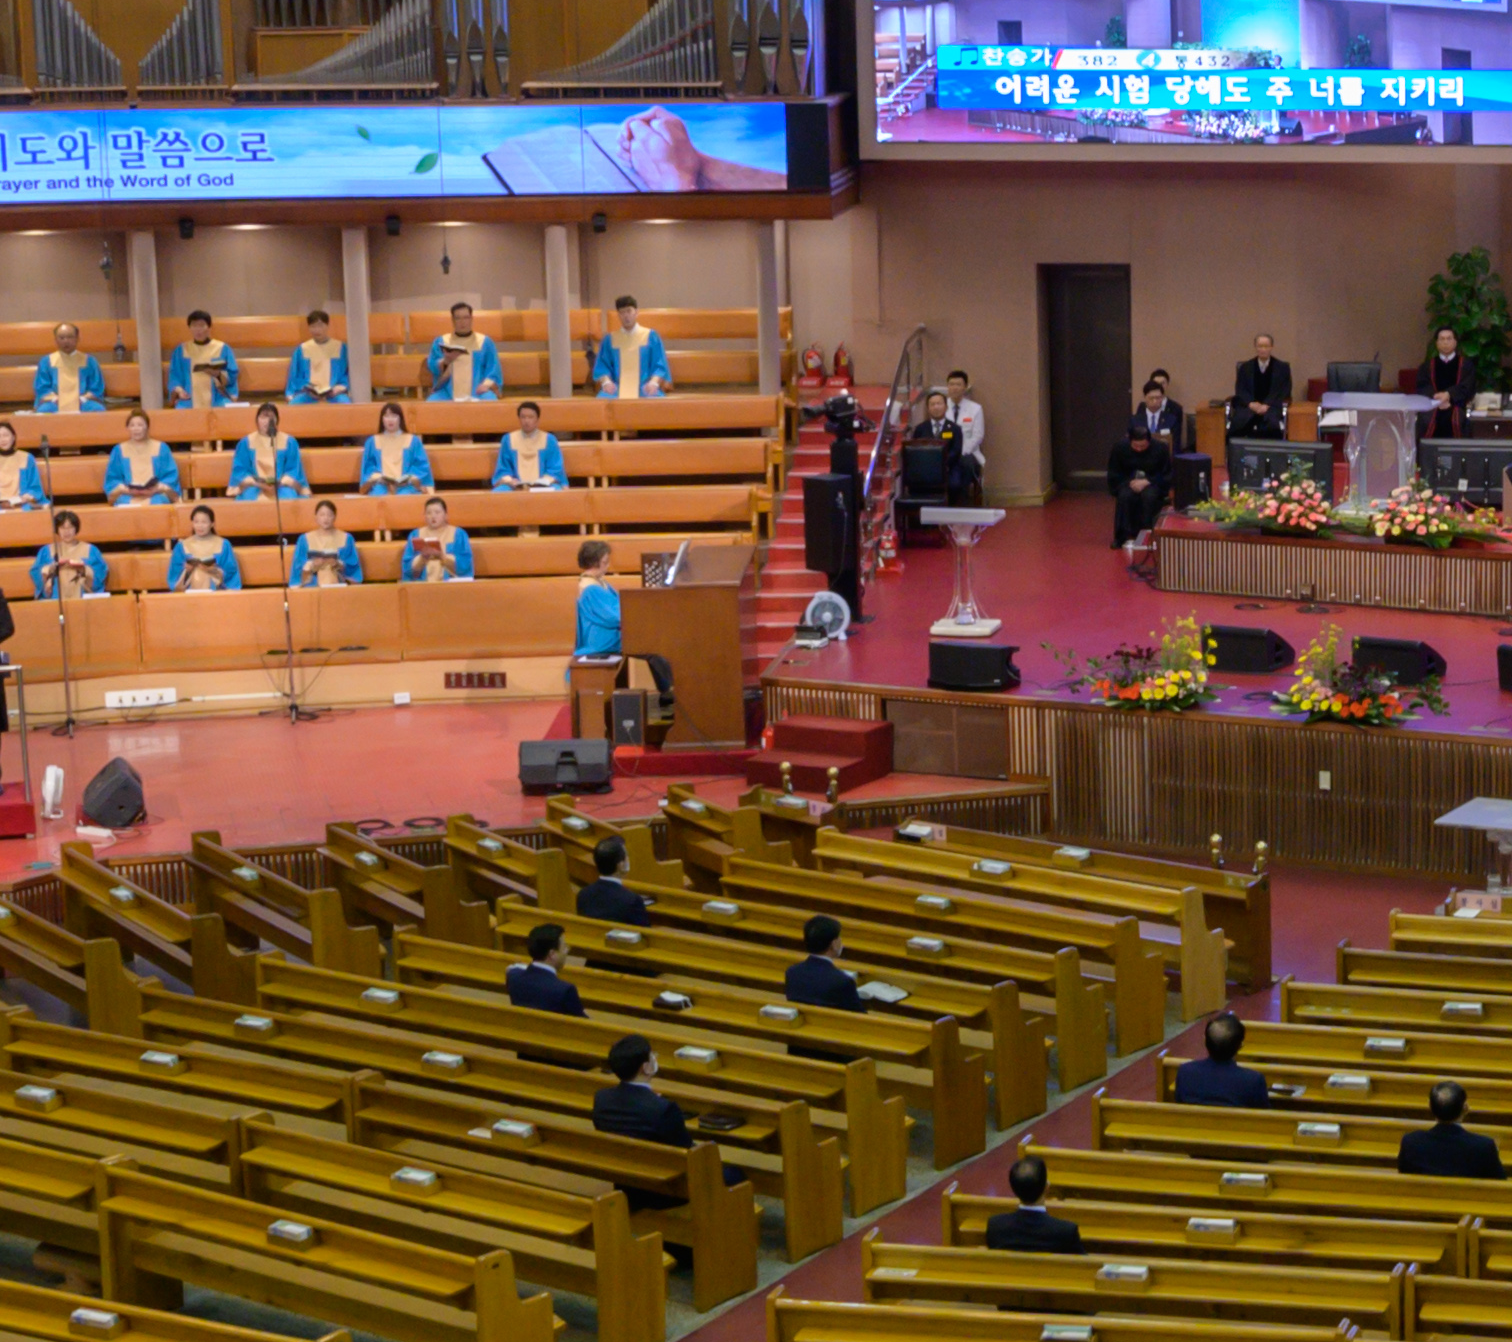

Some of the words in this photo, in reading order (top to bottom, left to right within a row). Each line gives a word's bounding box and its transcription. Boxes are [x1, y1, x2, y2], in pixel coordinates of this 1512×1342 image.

[982, 47, 1053, 67] 찬송가
[1078, 55, 1117, 67] 382
[1139, 52, 1155, 67] 4
[995, 74, 1080, 105] 어려운
[1095, 75, 1150, 105] 시험
[1165, 75, 1251, 105] 당해도
[1266, 76, 1293, 105] 주
[1380, 76, 1464, 107] 지키리
[111, 130, 275, 169] 말씀으로
[46, 176, 80, 189] and
[86, 175, 114, 188] the
[120, 174, 168, 187] Word
[174, 173, 192, 187] of
[197, 173, 234, 187] God
